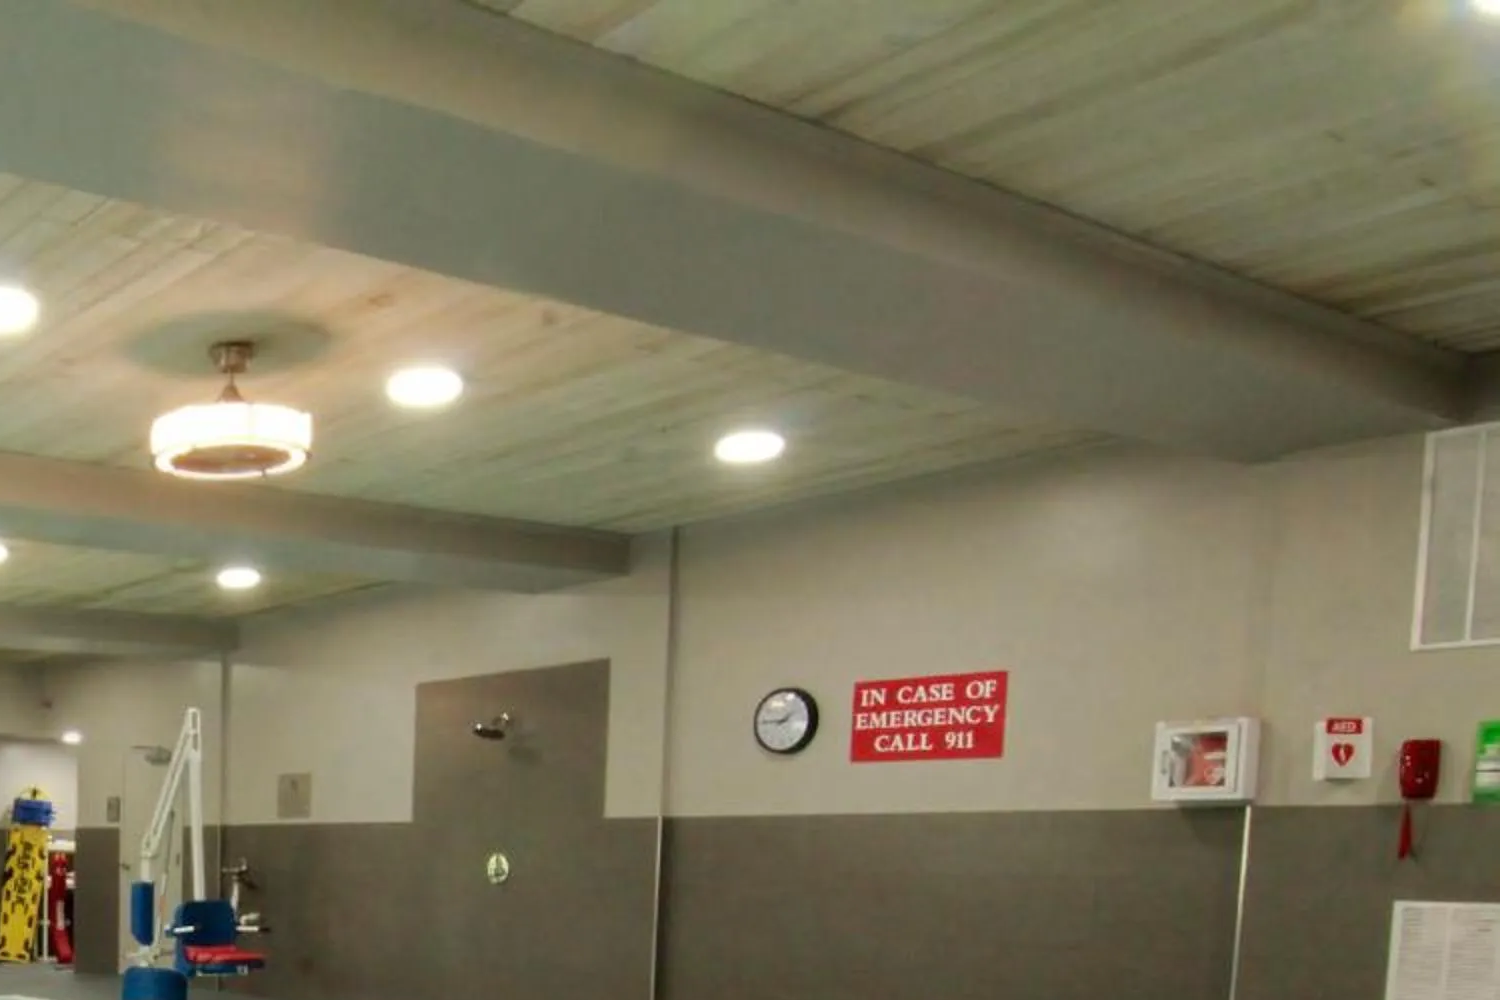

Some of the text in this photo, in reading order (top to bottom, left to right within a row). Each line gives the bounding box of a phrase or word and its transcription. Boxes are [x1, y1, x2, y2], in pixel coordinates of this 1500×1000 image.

[860, 679, 997, 707] IN CASE OF
[855, 704, 1000, 730] EMERGENCY
[873, 730, 974, 752] CALL 911
